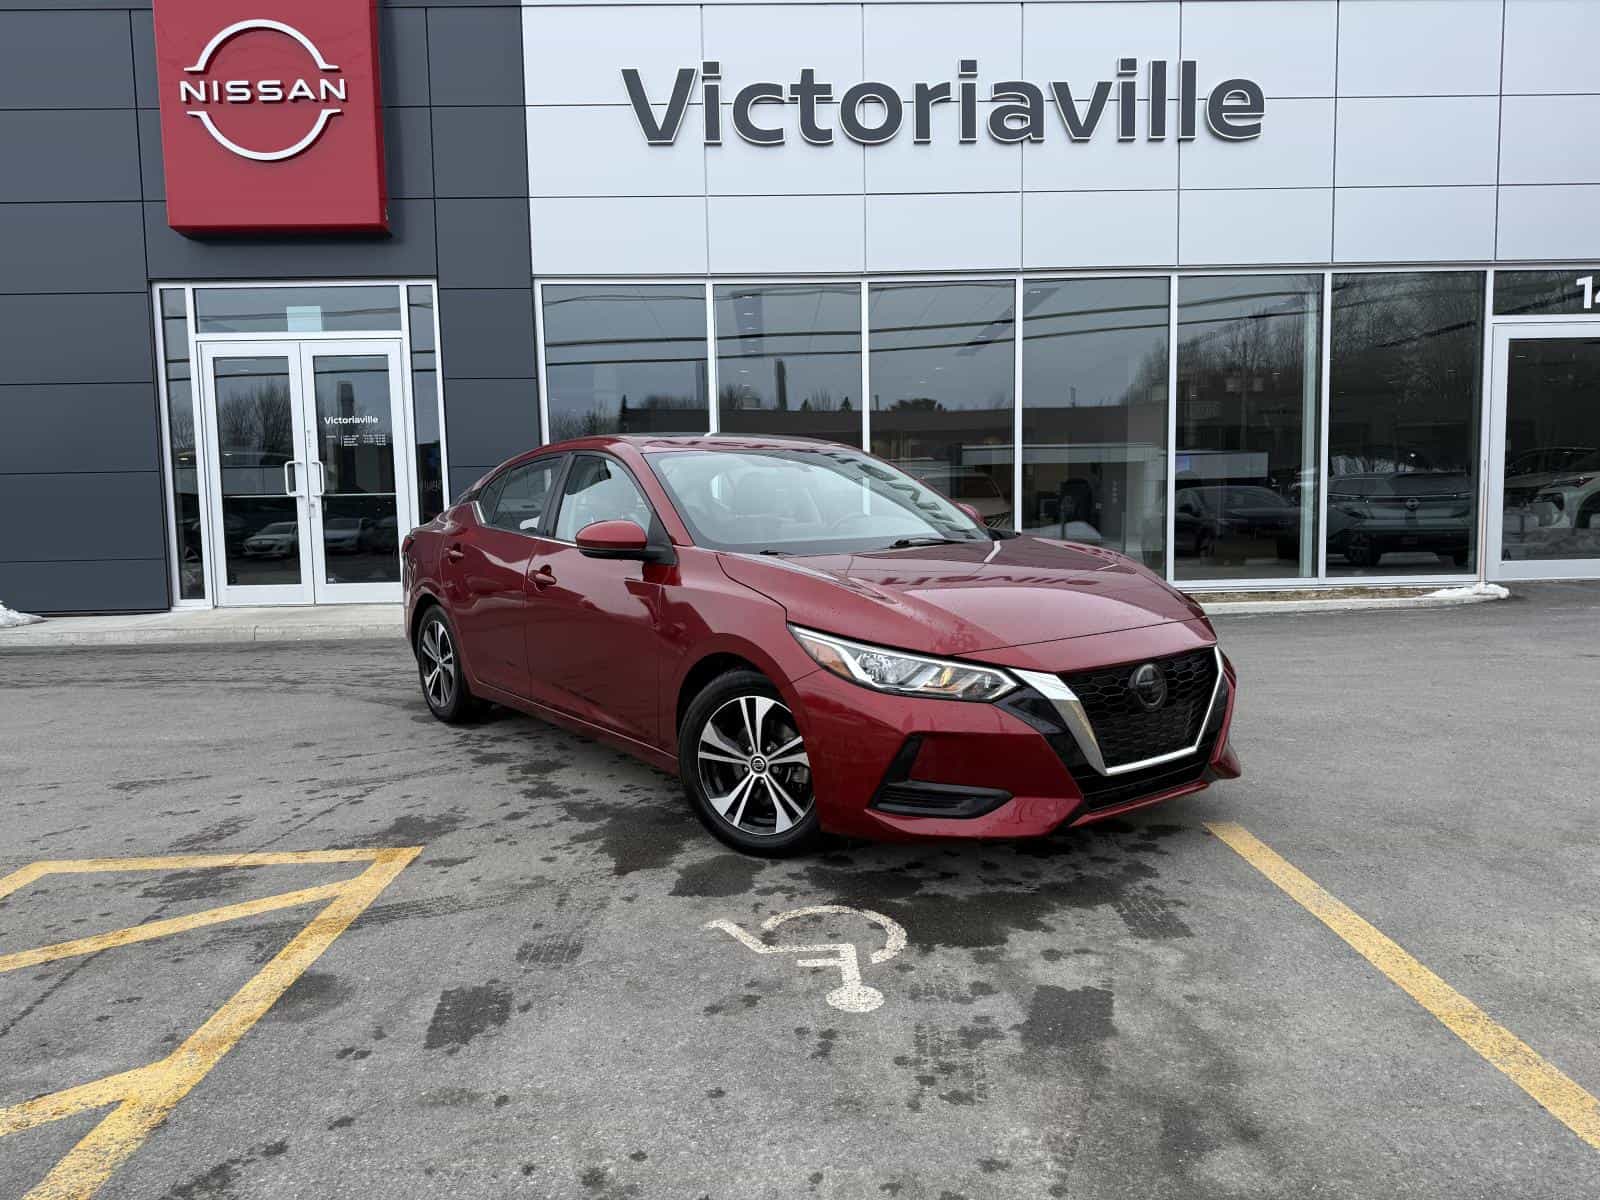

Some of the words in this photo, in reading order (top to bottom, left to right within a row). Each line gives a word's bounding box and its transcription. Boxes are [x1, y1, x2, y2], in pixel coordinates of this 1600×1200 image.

[180, 78, 347, 102] NISSAN
[620, 58, 1265, 145] Victoriaville
[1575, 275, 1600, 309] 1
[324, 415, 379, 425] Victoriaville
